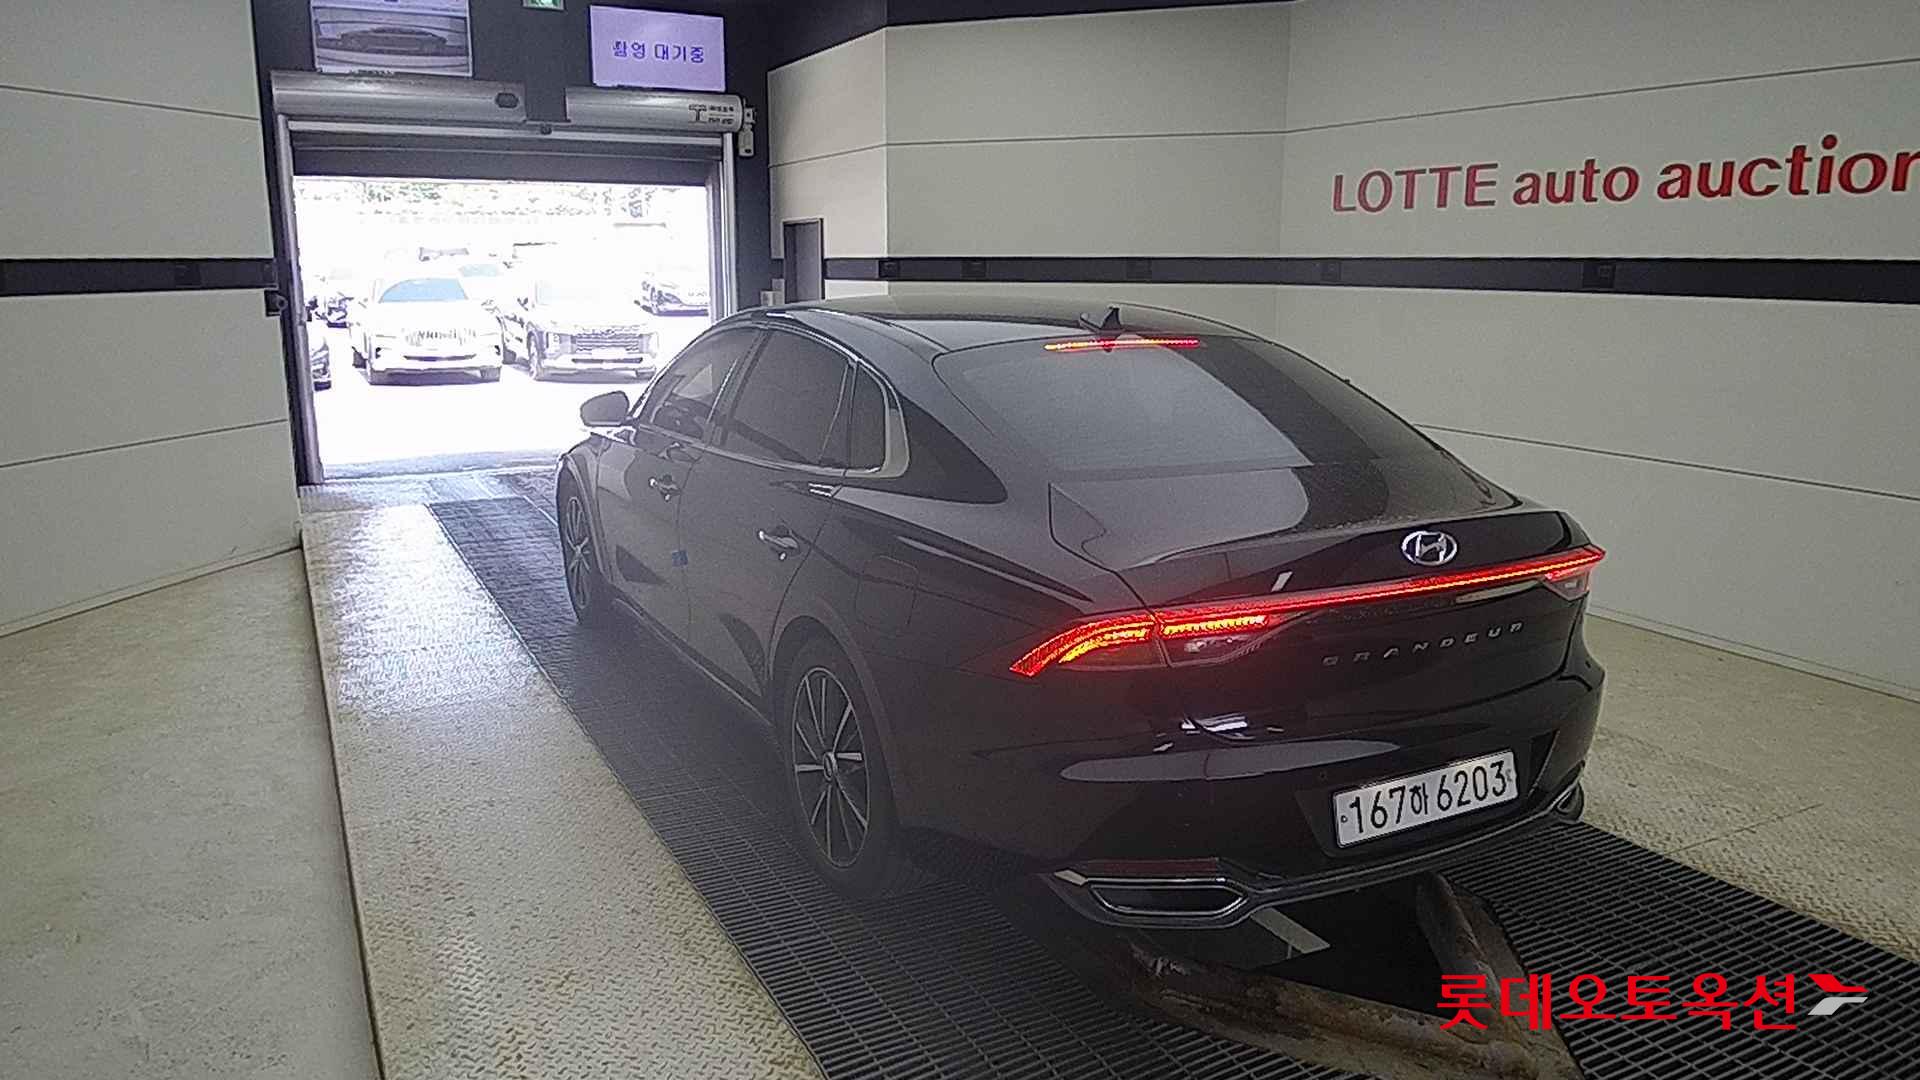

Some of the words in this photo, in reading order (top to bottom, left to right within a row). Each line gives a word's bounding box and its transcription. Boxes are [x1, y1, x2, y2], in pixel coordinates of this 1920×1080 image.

[654, 43, 705, 64] 대기중
[1332, 162, 1500, 213] LOTTE
[1512, 158, 1640, 206] auto
[1322, 620, 1523, 666] GRANDEUR
[1349, 782, 1429, 834] 167하
[1436, 760, 1508, 812] 6203
